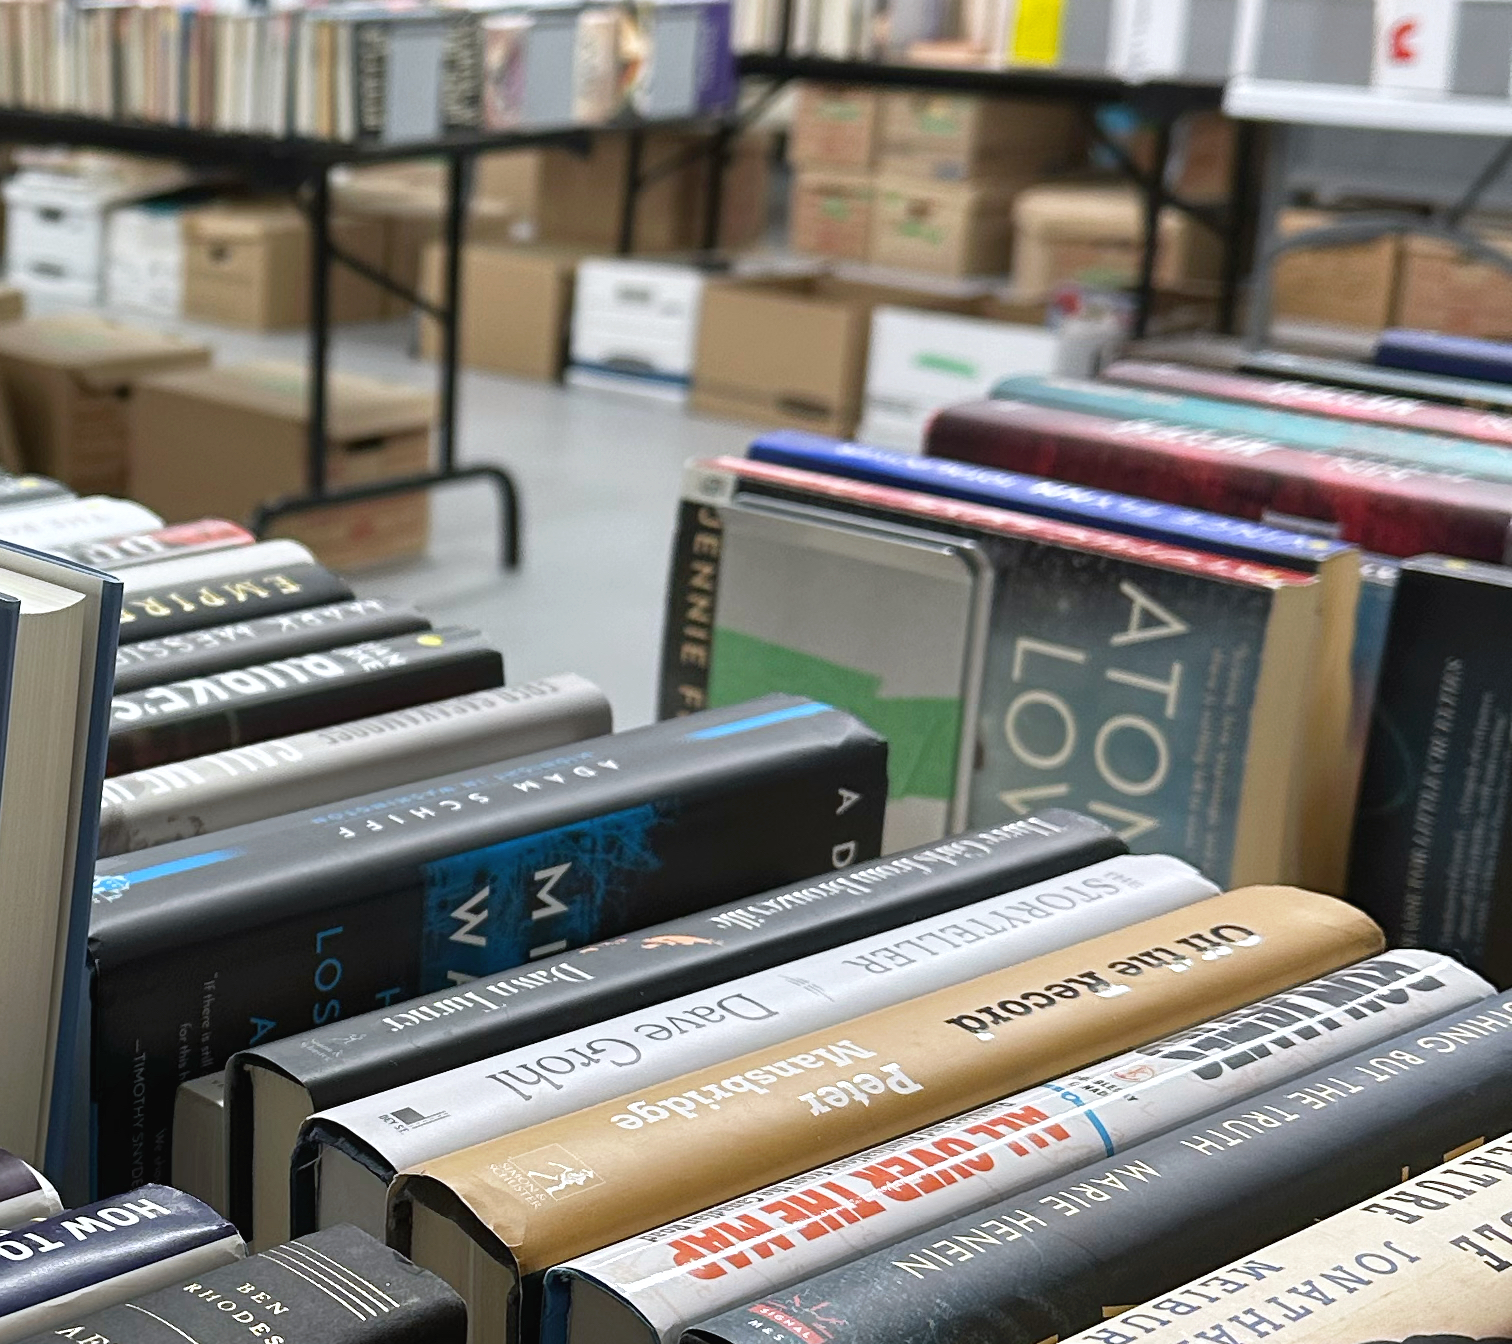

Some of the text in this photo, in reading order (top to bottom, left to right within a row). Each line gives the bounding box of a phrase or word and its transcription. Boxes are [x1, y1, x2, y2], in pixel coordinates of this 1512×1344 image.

[679, 506, 723, 670] JENNIE
[513, 756, 622, 796] ADAM
[335, 790, 492, 840] SCHIFF
[382, 984, 488, 1034] Turner
[484, 872, 1121, 1102] STORYTELLER Dave Grohl
[496, 961, 597, 1006] Dawn
[610, 1039, 878, 1132] Mansbridge
[797, 1062, 925, 1118] Peter
[1289, 1069, 1362, 1113] THE
[1353, 1046, 1427, 1096] BUT
[964, 1104, 1073, 1158] ALL
[1179, 1098, 1300, 1158] TRUTH
[849, 1136, 996, 1203] OVER
[1061, 1159, 1162, 1219] MARIE
[61, 1196, 171, 1249] HOW
[760, 1180, 887, 1241] THE
[666, 1213, 797, 1282] MAP
[889, 1205, 1048, 1280] HENEIN
[237, 1281, 290, 1317] BEN
[756, 1304, 814, 1342] SIGNAL
